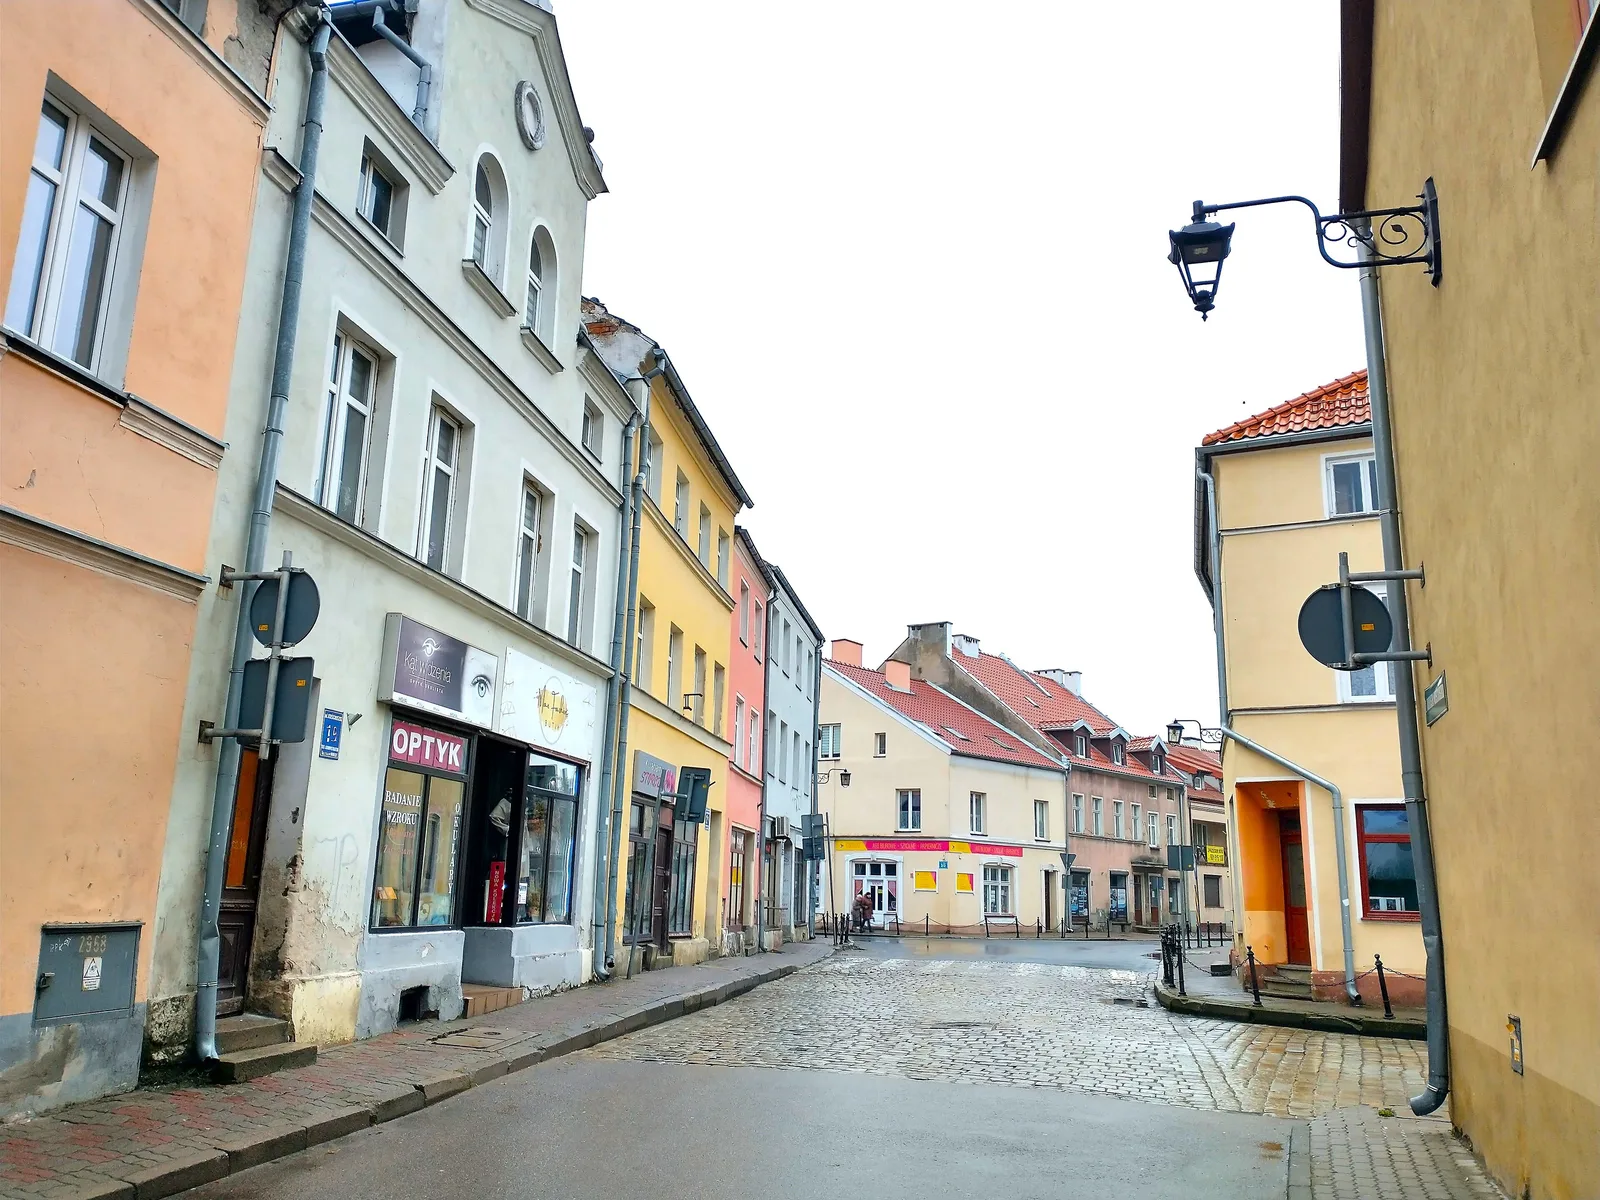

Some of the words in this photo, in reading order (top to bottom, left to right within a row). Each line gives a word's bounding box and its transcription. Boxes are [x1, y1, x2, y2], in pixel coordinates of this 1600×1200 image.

[393, 728, 461, 767] OPTYK
[384, 790, 421, 807] BADANIE
[386, 809, 417, 825] WZROKU
[448, 802, 461, 894] OKULARY
